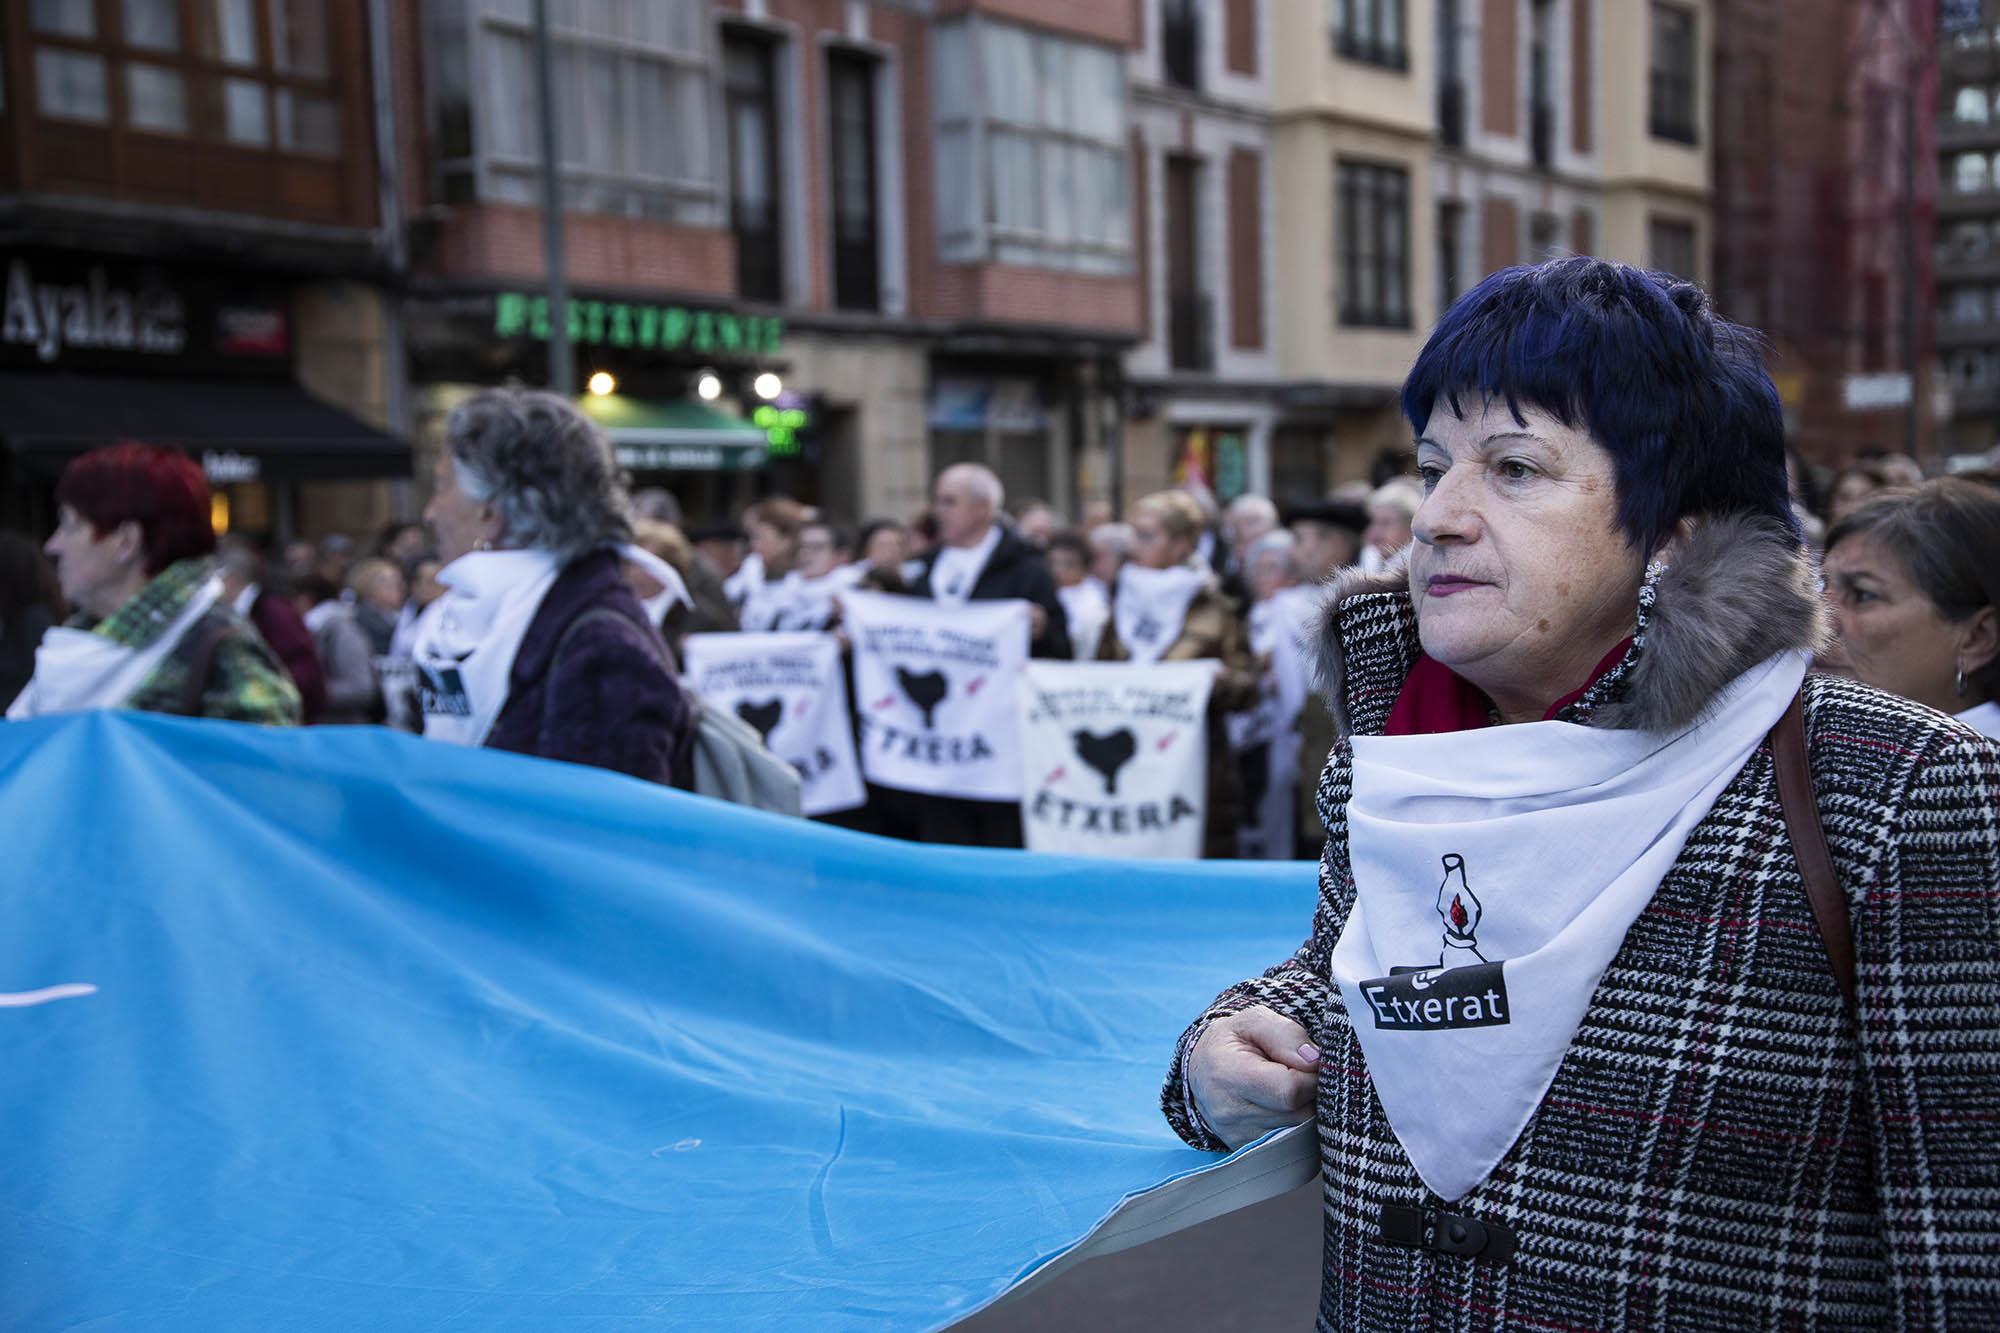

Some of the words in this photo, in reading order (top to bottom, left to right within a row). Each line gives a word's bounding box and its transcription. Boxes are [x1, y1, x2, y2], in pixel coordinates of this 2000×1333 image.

[2, 257, 136, 363] Ayala
[1032, 790, 1196, 836] ETXERA
[1366, 986, 1503, 1024] Etxerat
